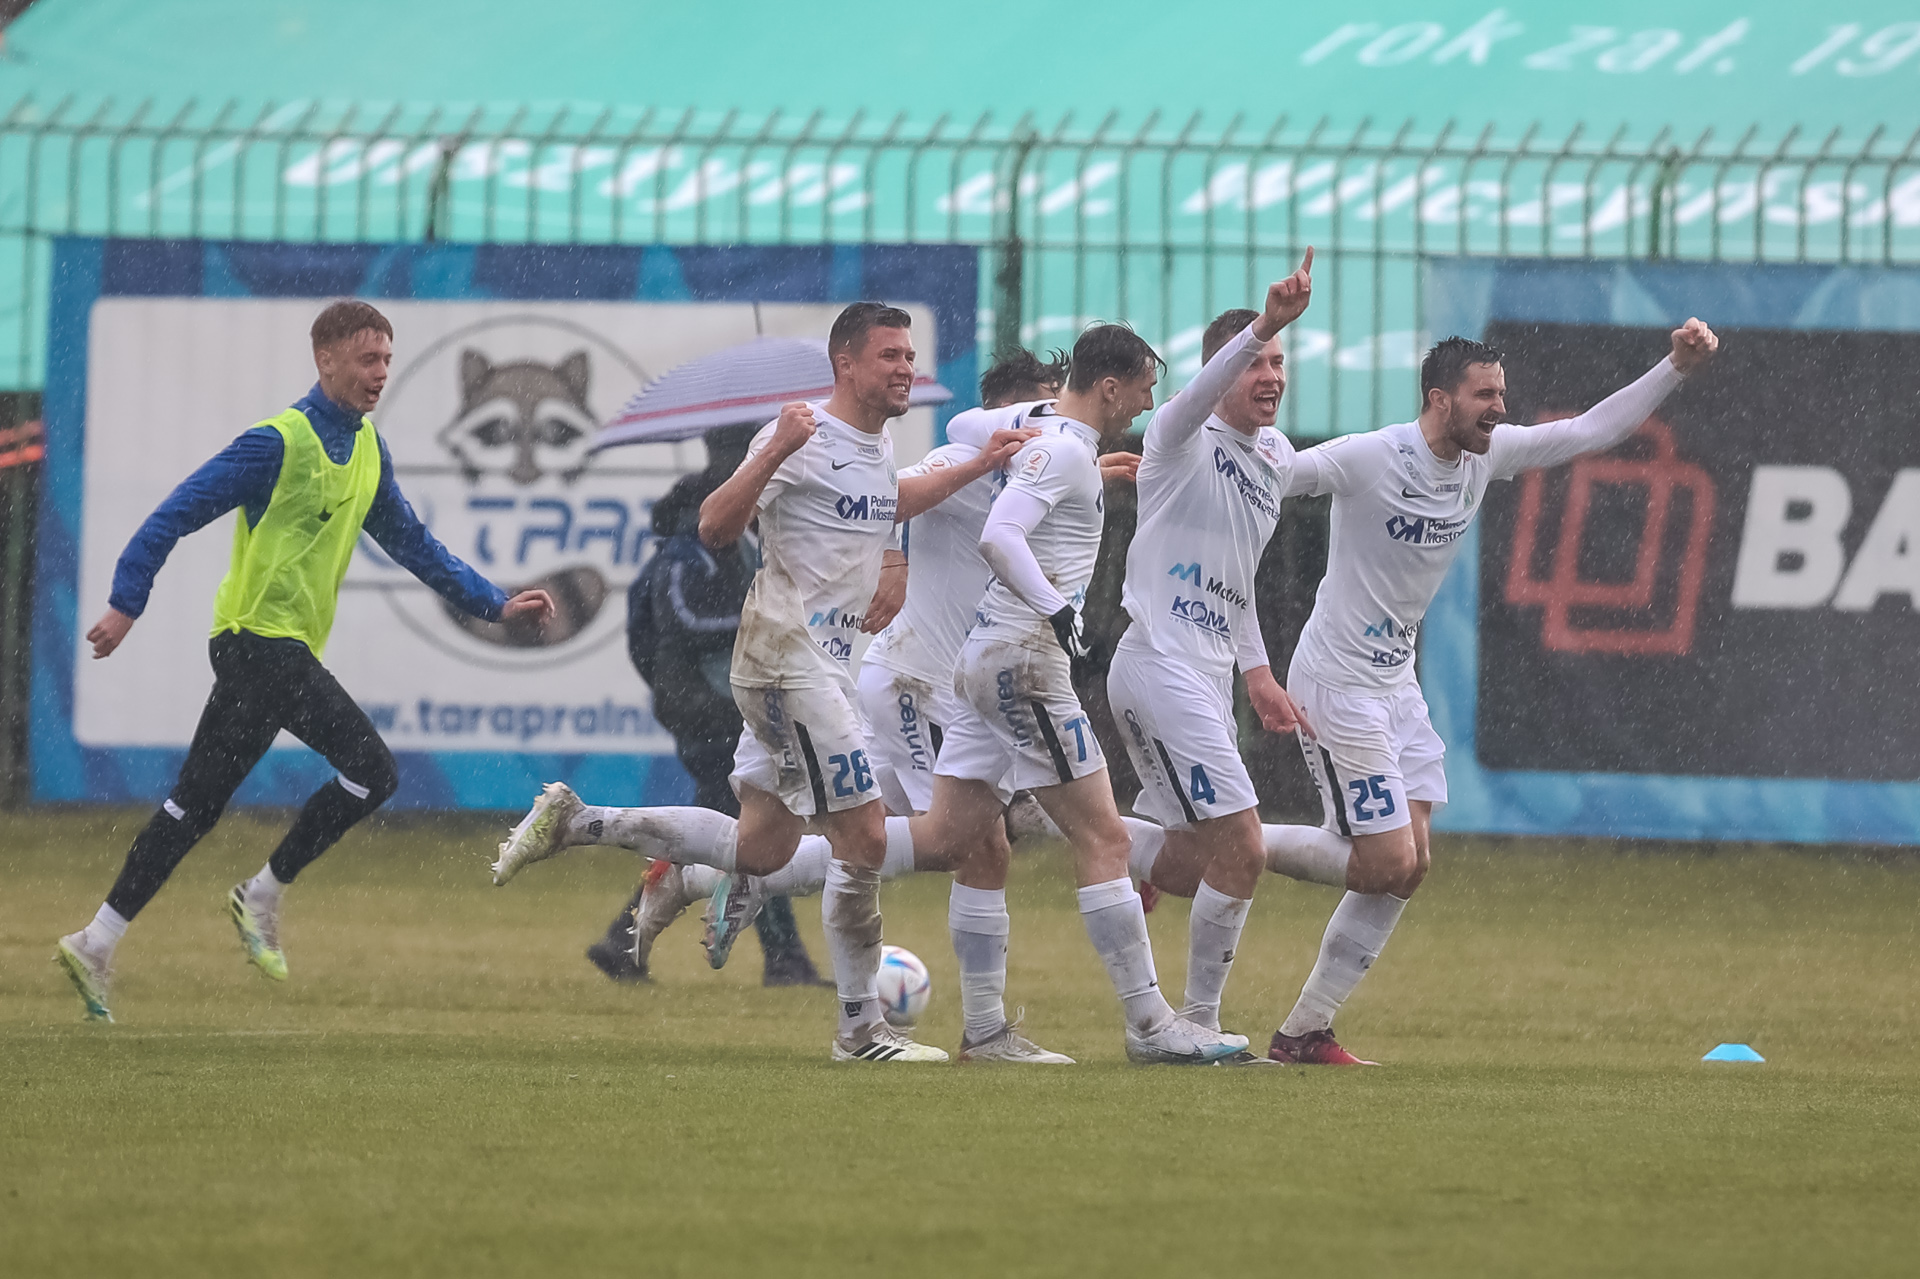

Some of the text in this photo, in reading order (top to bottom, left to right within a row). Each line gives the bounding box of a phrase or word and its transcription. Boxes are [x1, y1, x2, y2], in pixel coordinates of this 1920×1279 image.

[1300, 6, 1526, 66] rok
[1190, 763, 1217, 805] 4
[1349, 775, 1395, 821] 25
